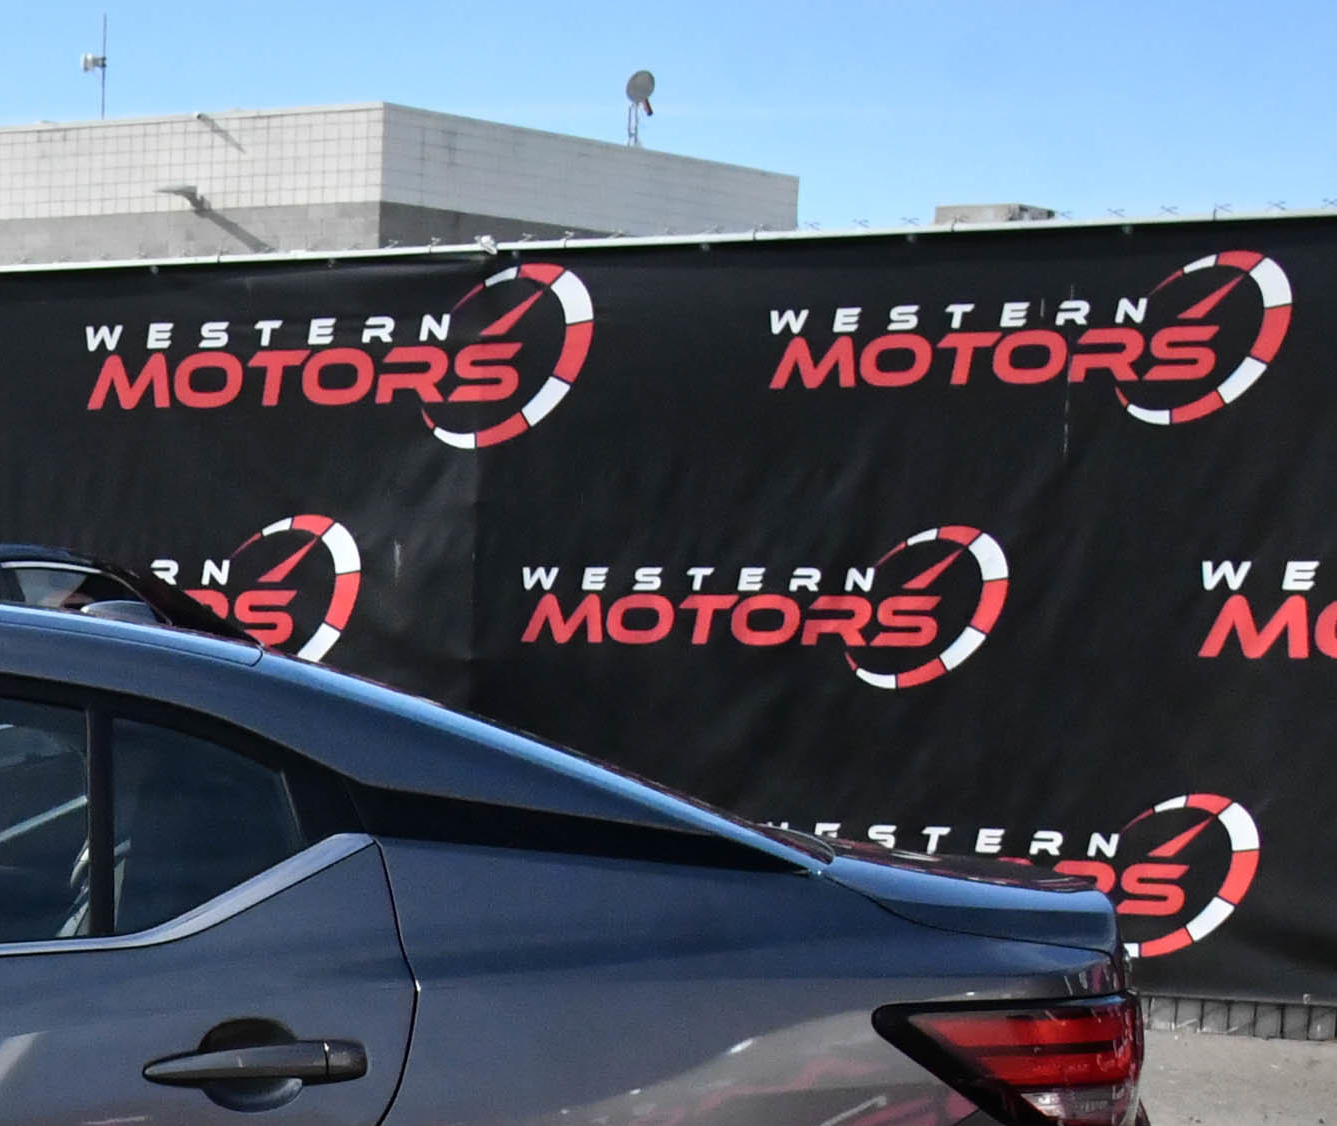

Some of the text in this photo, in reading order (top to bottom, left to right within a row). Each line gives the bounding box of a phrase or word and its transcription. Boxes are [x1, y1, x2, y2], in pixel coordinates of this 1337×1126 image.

[86, 313, 451, 352] WESTERN
[770, 297, 1148, 335] WESTERN
[88, 342, 522, 410] MOTORS
[770, 324, 1220, 390] MOTORS
[522, 566, 875, 592] WESTERN
[522, 593, 941, 648] MOTORS
[767, 821, 1120, 858] ESTERN
